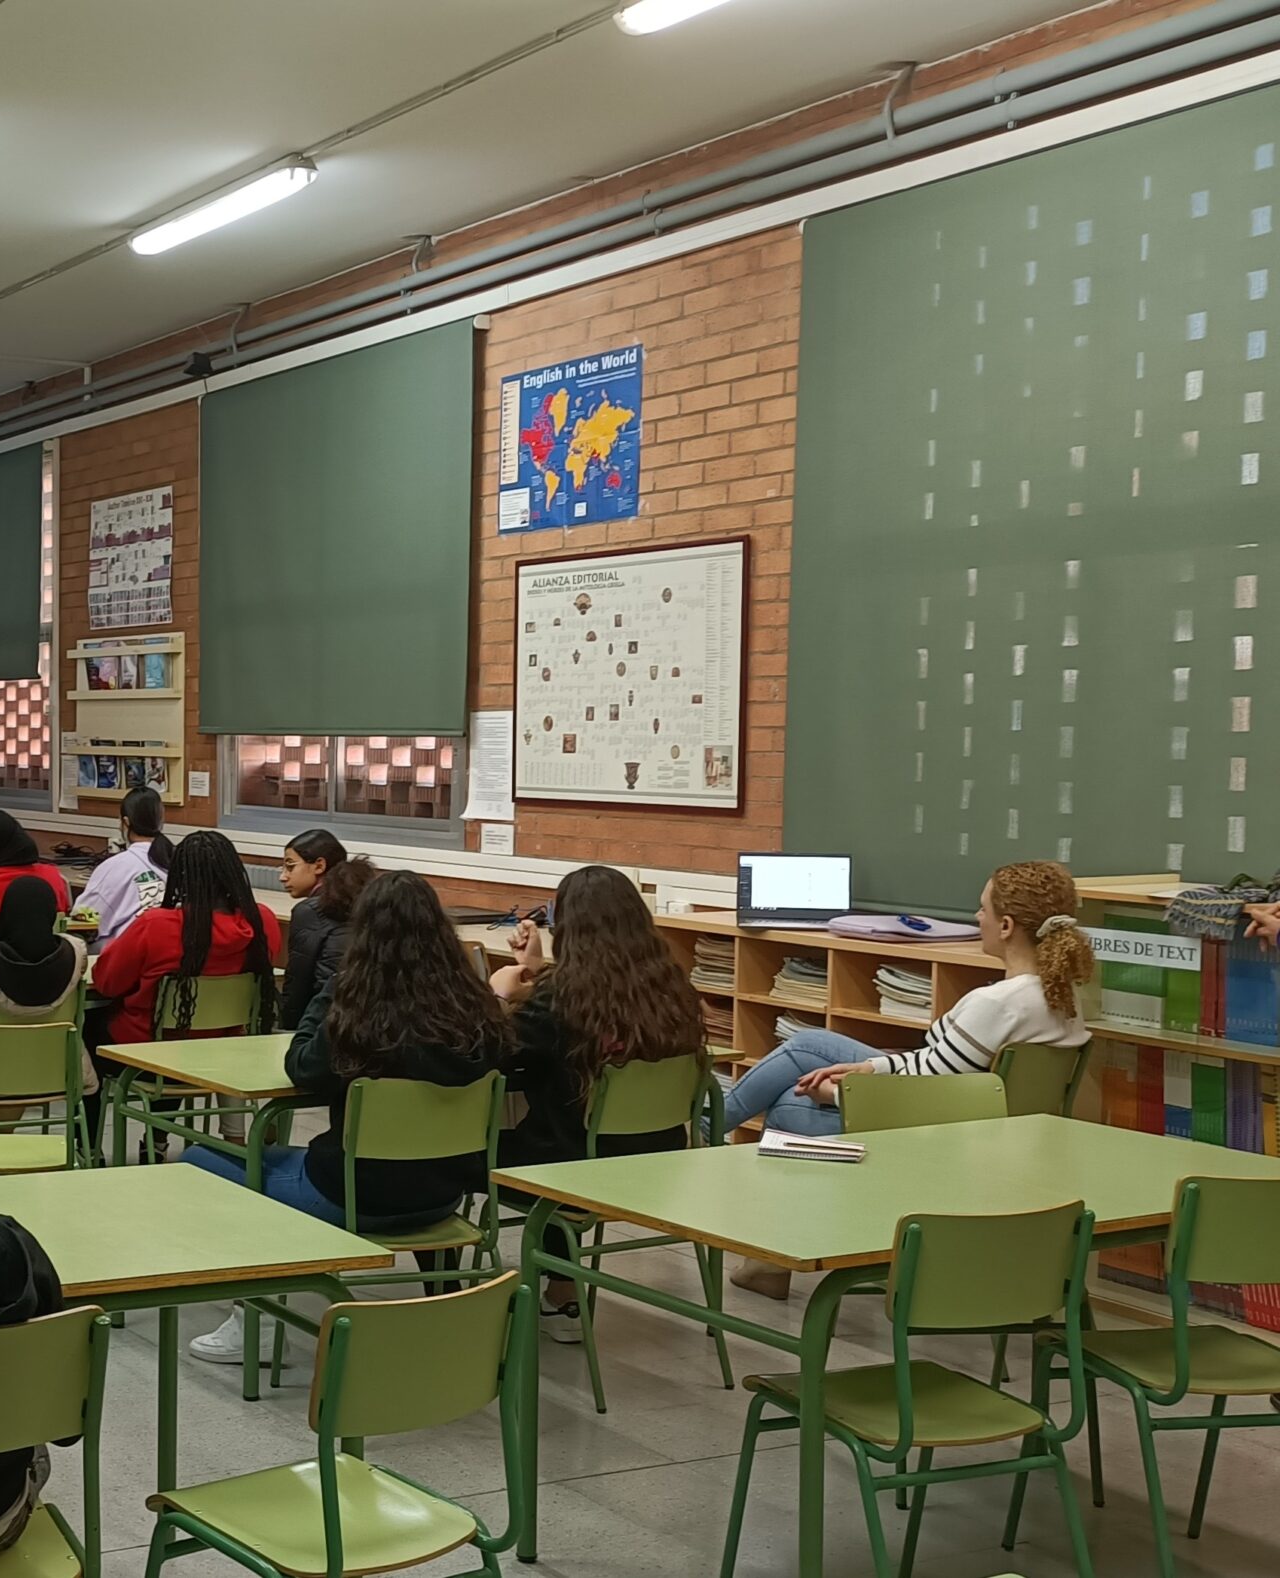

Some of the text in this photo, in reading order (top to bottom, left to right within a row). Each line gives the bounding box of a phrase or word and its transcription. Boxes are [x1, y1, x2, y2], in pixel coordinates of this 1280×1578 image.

[523, 348, 637, 389] English in the World
[532, 571, 620, 588] ALIANZA EDITORIAL
[1133, 942, 1154, 957] DE
[1157, 944, 1197, 962] TEXT
